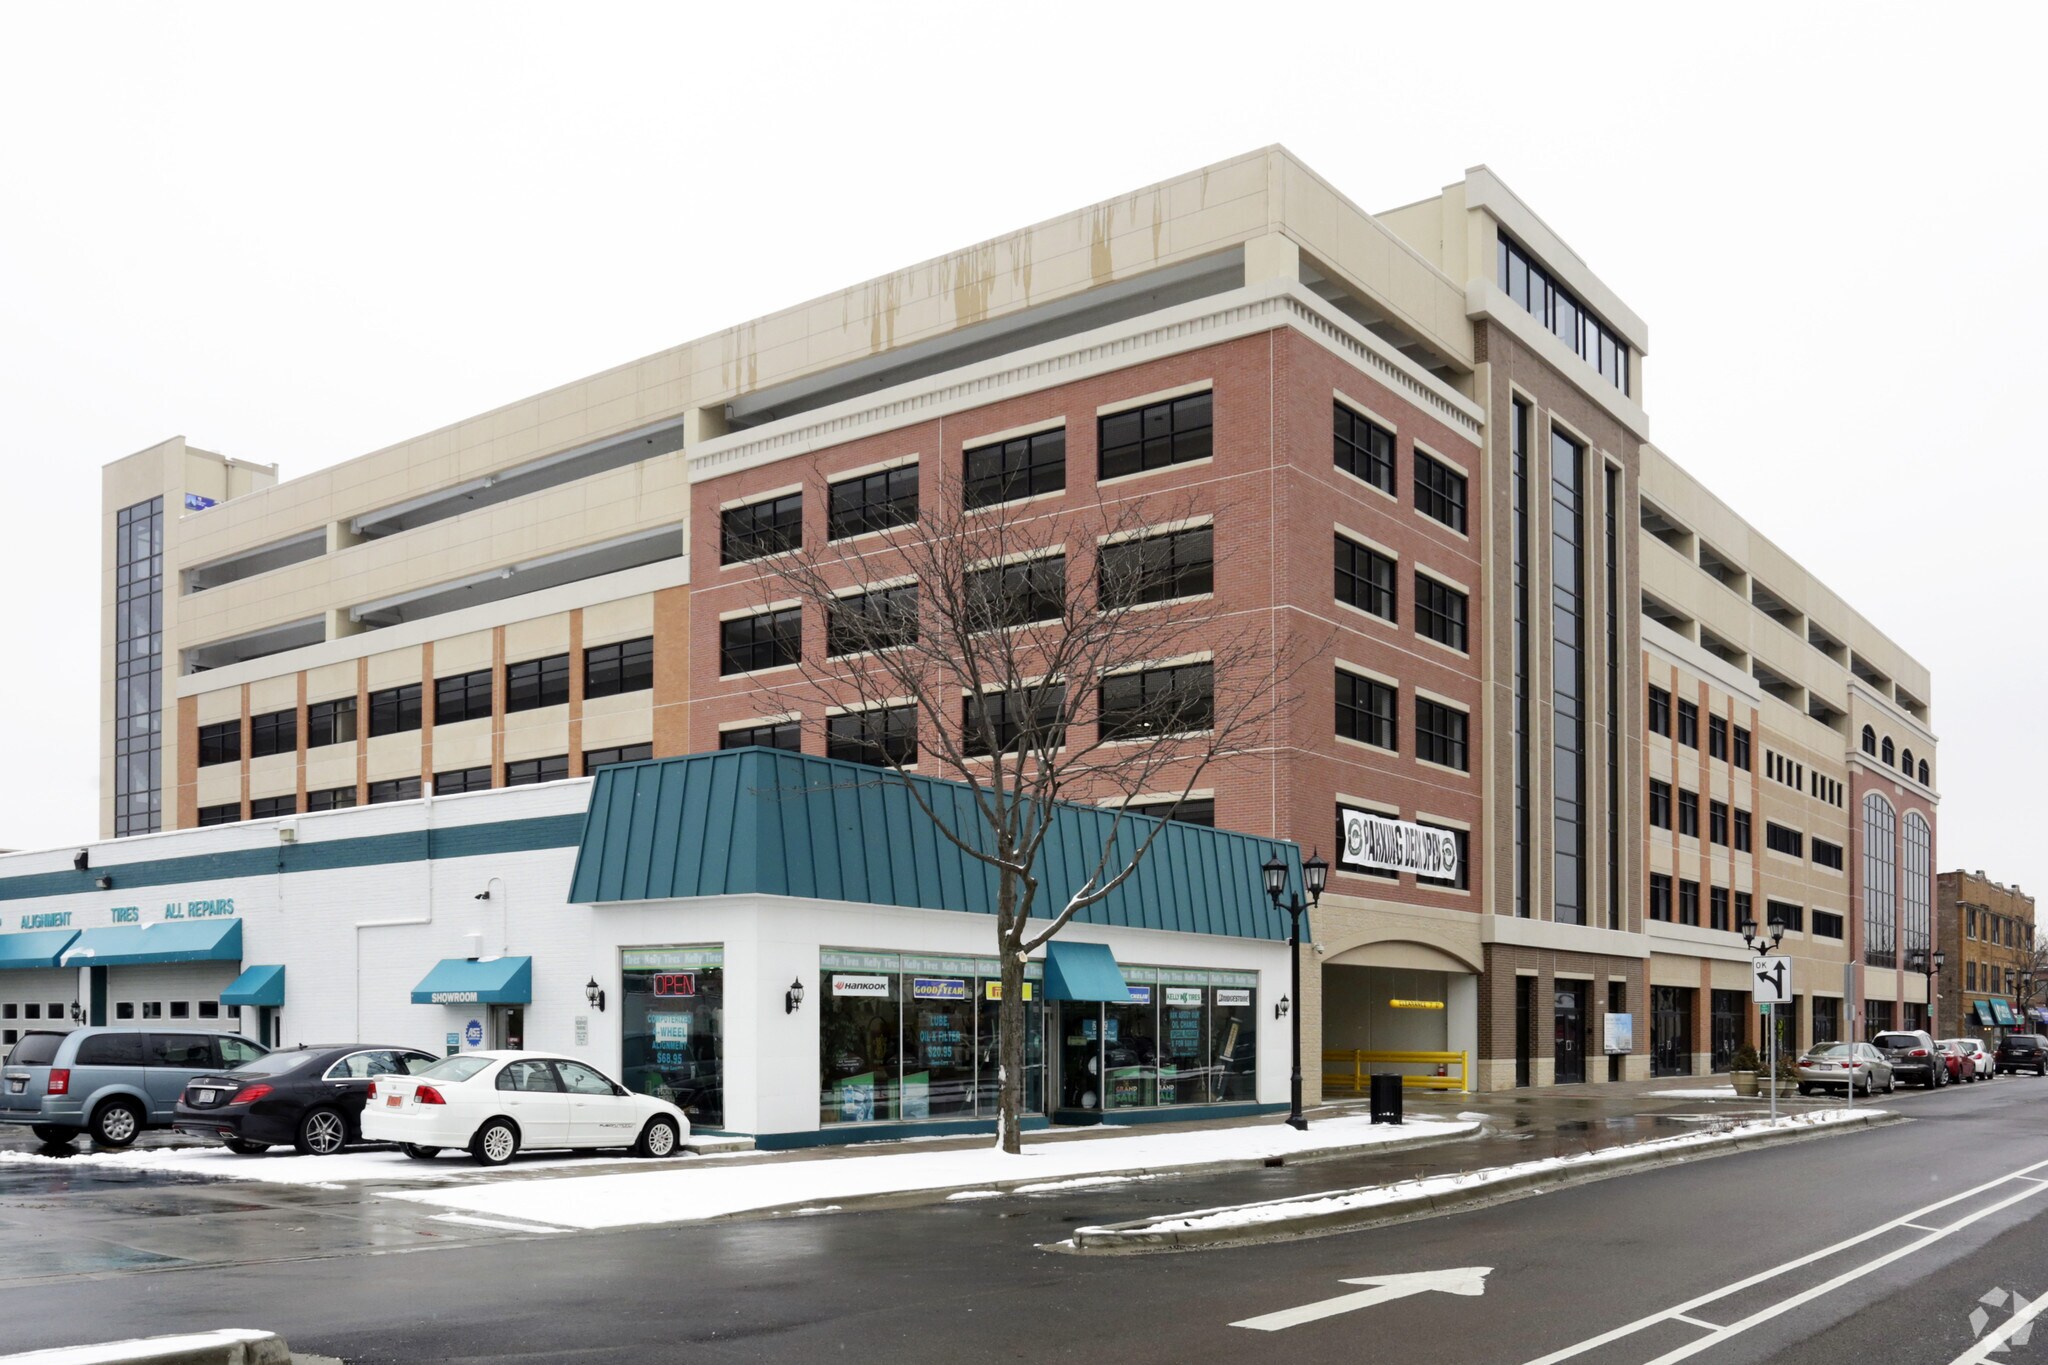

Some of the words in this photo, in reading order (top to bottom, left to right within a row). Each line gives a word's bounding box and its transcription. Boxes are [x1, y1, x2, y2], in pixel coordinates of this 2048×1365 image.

[1363, 819, 1403, 866] PARKING
[165, 903, 184, 919] ALL
[188, 898, 234, 917] REPAIRS
[21, 911, 72, 929] ALIGNMENT
[111, 907, 139, 923] TIRES
[656, 975, 694, 995] OPEN
[431, 992, 478, 1003] SHOWROOM
[468, 1027, 480, 1037] ASE
[920, 1030, 930, 1042] OIL
[939, 1030, 960, 1042] FILTER
[652, 1041, 688, 1050] ALIGNMENT
[657, 1052, 682, 1064] $68.95
[1116, 1094, 1138, 1102] SALE
[1160, 1092, 1174, 1100] ALE
